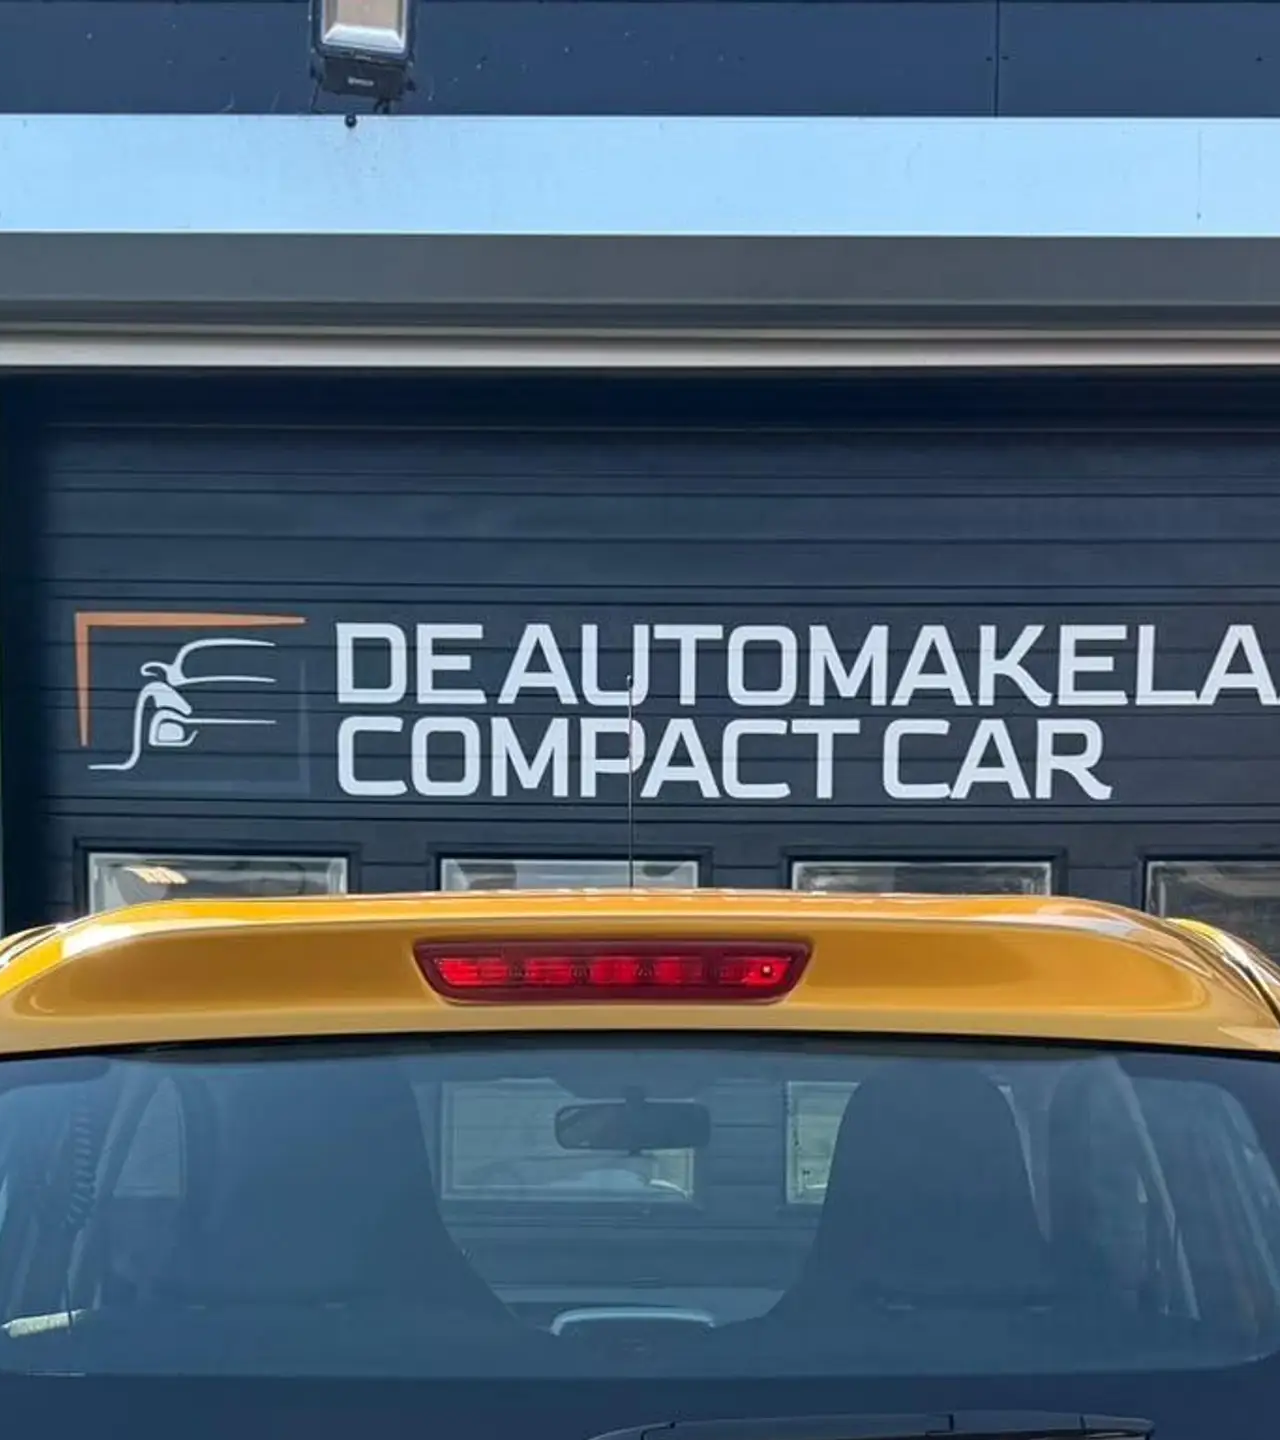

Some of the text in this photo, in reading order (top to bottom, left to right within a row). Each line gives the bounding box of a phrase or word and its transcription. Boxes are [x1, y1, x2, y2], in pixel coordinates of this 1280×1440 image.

[336, 623, 483, 704] DE
[338, 716, 1112, 800] COMPACT CAR
